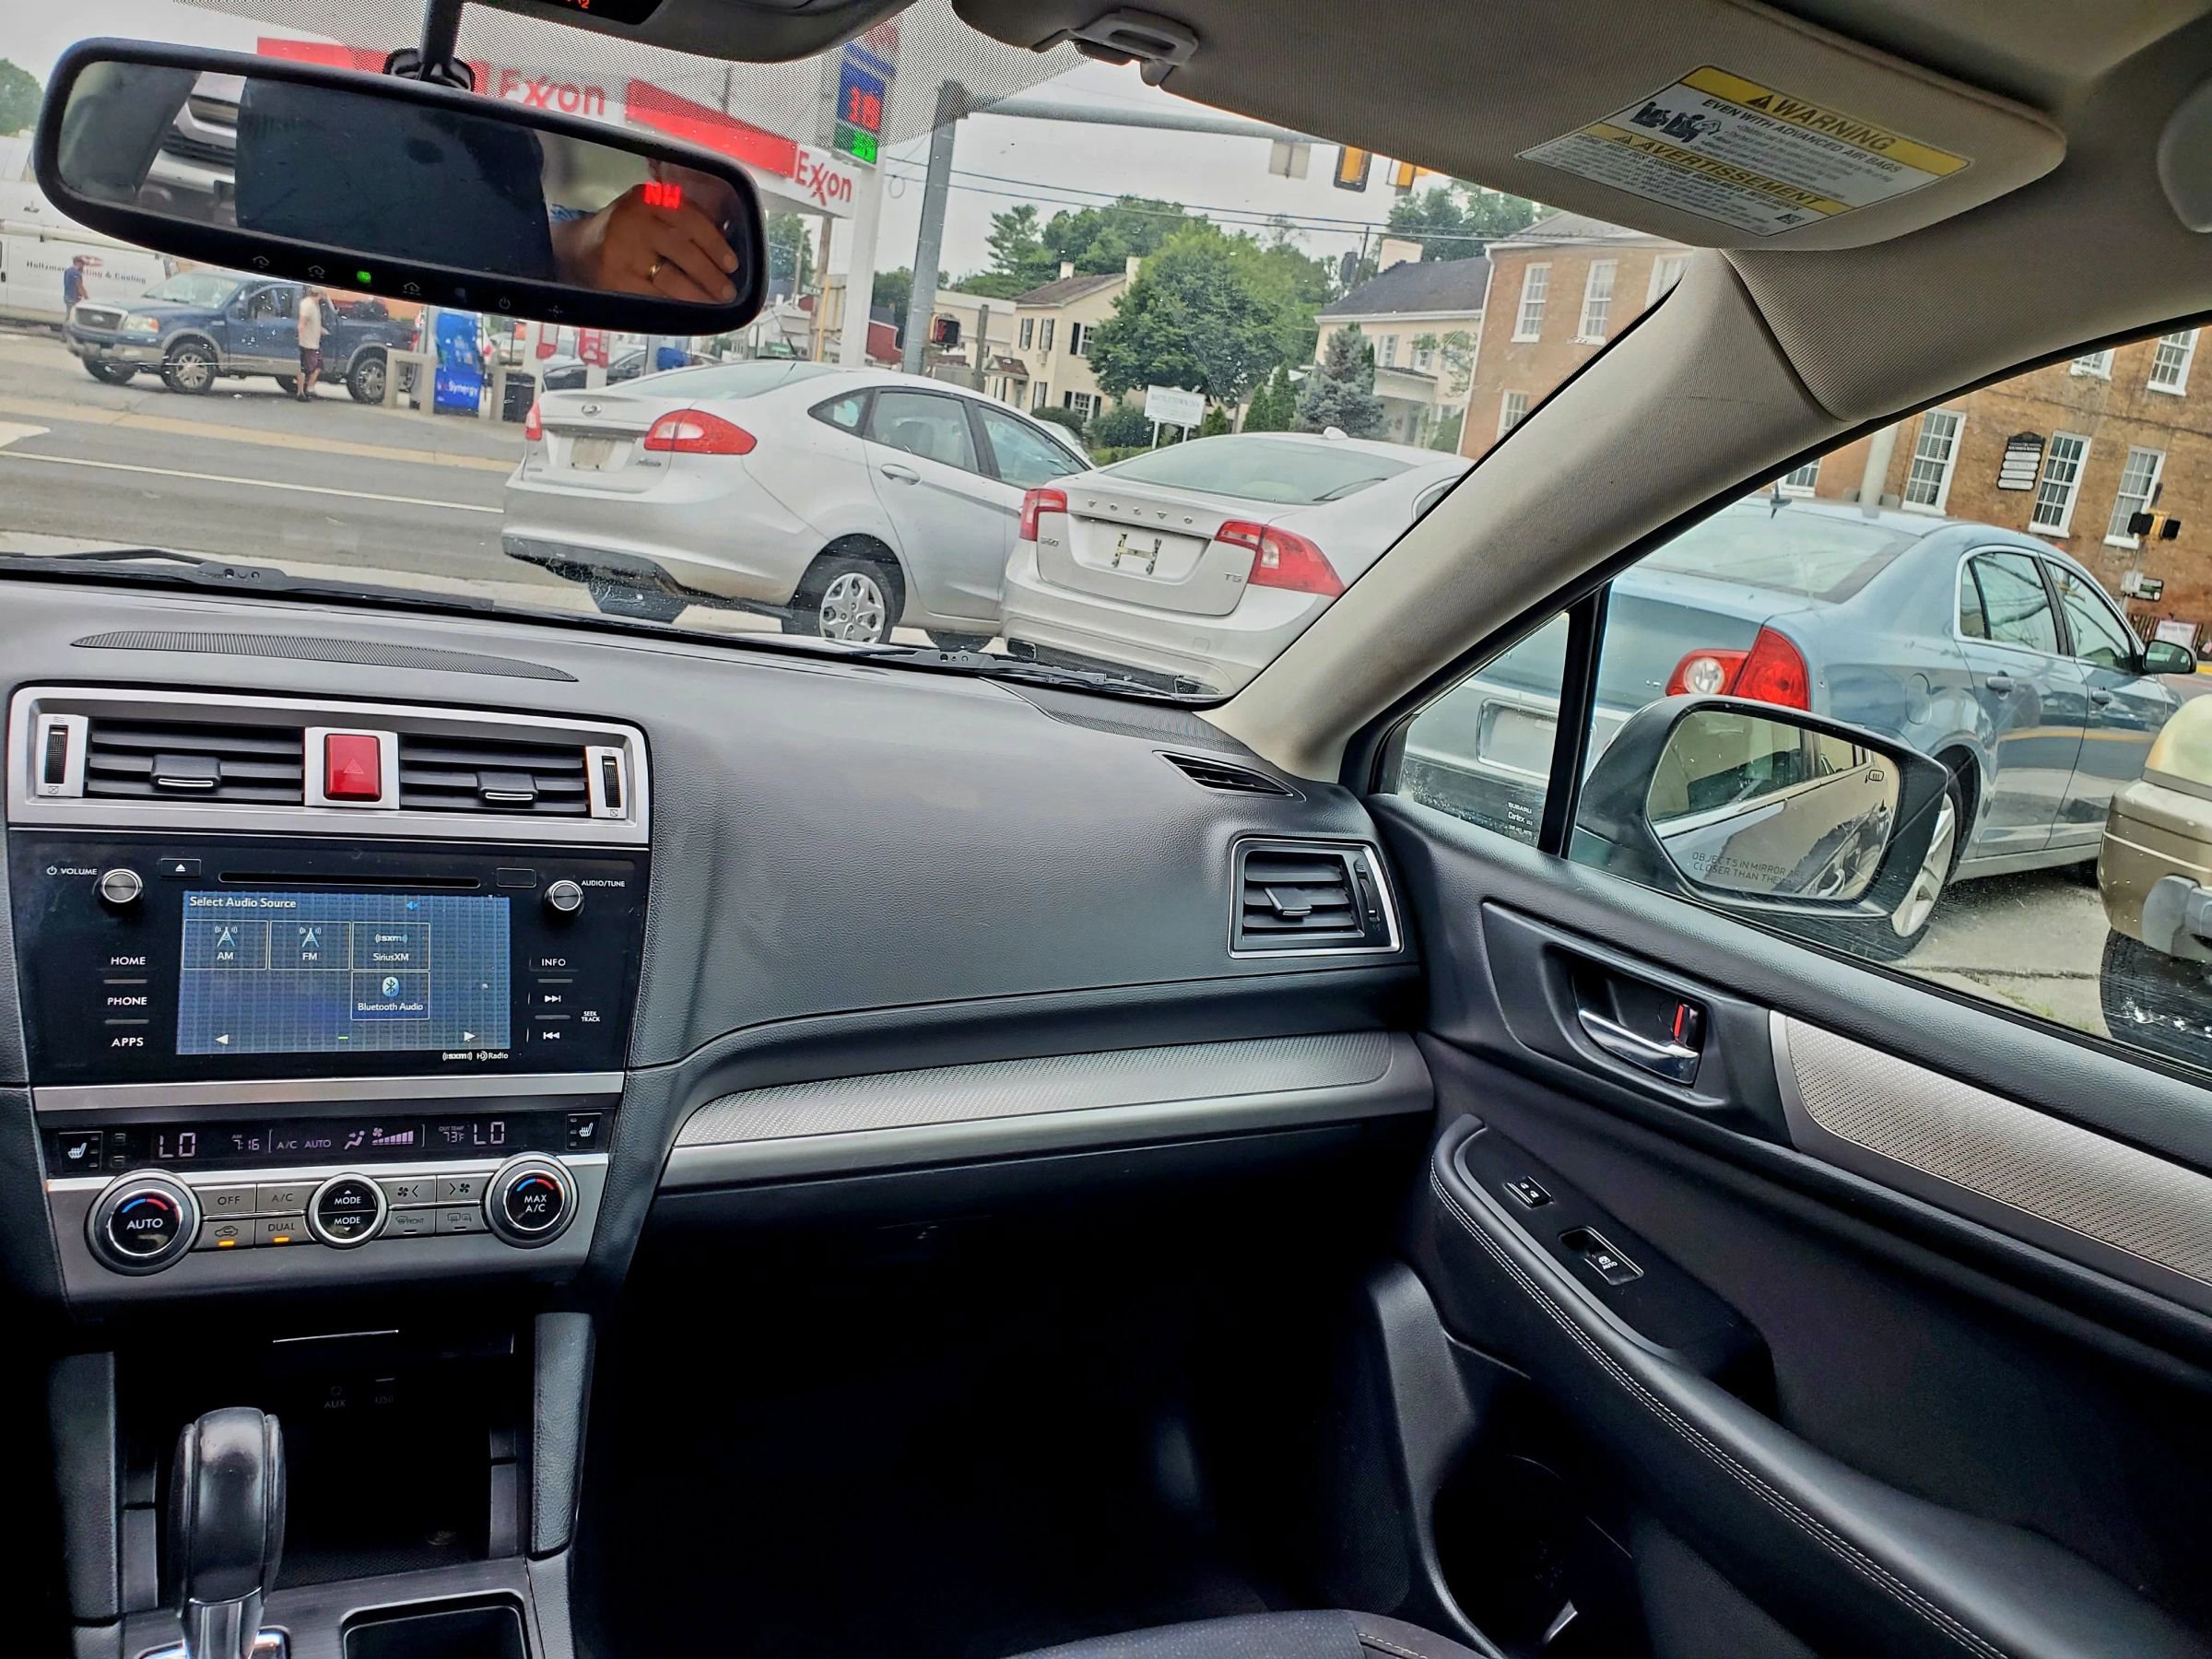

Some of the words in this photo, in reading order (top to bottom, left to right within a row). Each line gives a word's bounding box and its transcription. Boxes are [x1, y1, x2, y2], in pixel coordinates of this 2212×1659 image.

[500, 68, 605, 115] Exxon
[1771, 96, 1897, 151] WARNING
[1702, 99, 1744, 120] EVEN
[1740, 110, 1775, 129] WITH
[1775, 124, 1843, 153] ADVANCED
[1843, 145, 1867, 160] AIR
[1866, 155, 1903, 173] BAGS
[1634, 138, 1827, 206] AVERTISSEMENT
[794, 150, 853, 206] Exxon
[643, 181, 682, 208] NW
[1088, 500, 1194, 524] VOLVO
[1508, 802, 1532, 814] SUBARU
[1692, 852, 1738, 867] OBJECTS
[1739, 859, 1749, 868] IN
[1751, 861, 1786, 876] MIRROR
[1693, 862, 1734, 875] CLOSER
[1734, 869, 1759, 881] THAN
[190, 897, 223, 907] Select
[226, 898, 258, 908] Audio
[260, 899, 296, 909] Source
[111, 957, 146, 965] HOME
[217, 952, 233, 960] AM
[302, 952, 318, 961] FM
[372, 952, 409, 961] SiriusXM
[107, 996, 147, 1006] PHONE
[358, 1003, 397, 1011] Bluetooth
[399, 1003, 424, 1011] Audio
[112, 1037, 144, 1047] APPS
[233, 1138, 260, 1151] 7:16
[276, 1140, 298, 1149] A/C
[304, 1139, 332, 1148] AUTO
[217, 1196, 241, 1206] OFF
[271, 1193, 294, 1203] A/C
[334, 1196, 361, 1206] MODE
[524, 1194, 547, 1204] MAX
[524, 1204, 546, 1213] A/C
[126, 1218, 163, 1230] AUTO
[334, 1216, 361, 1226] MODE
[267, 1222, 295, 1232] DUAL
[324, 1399, 347, 1408] AUX
